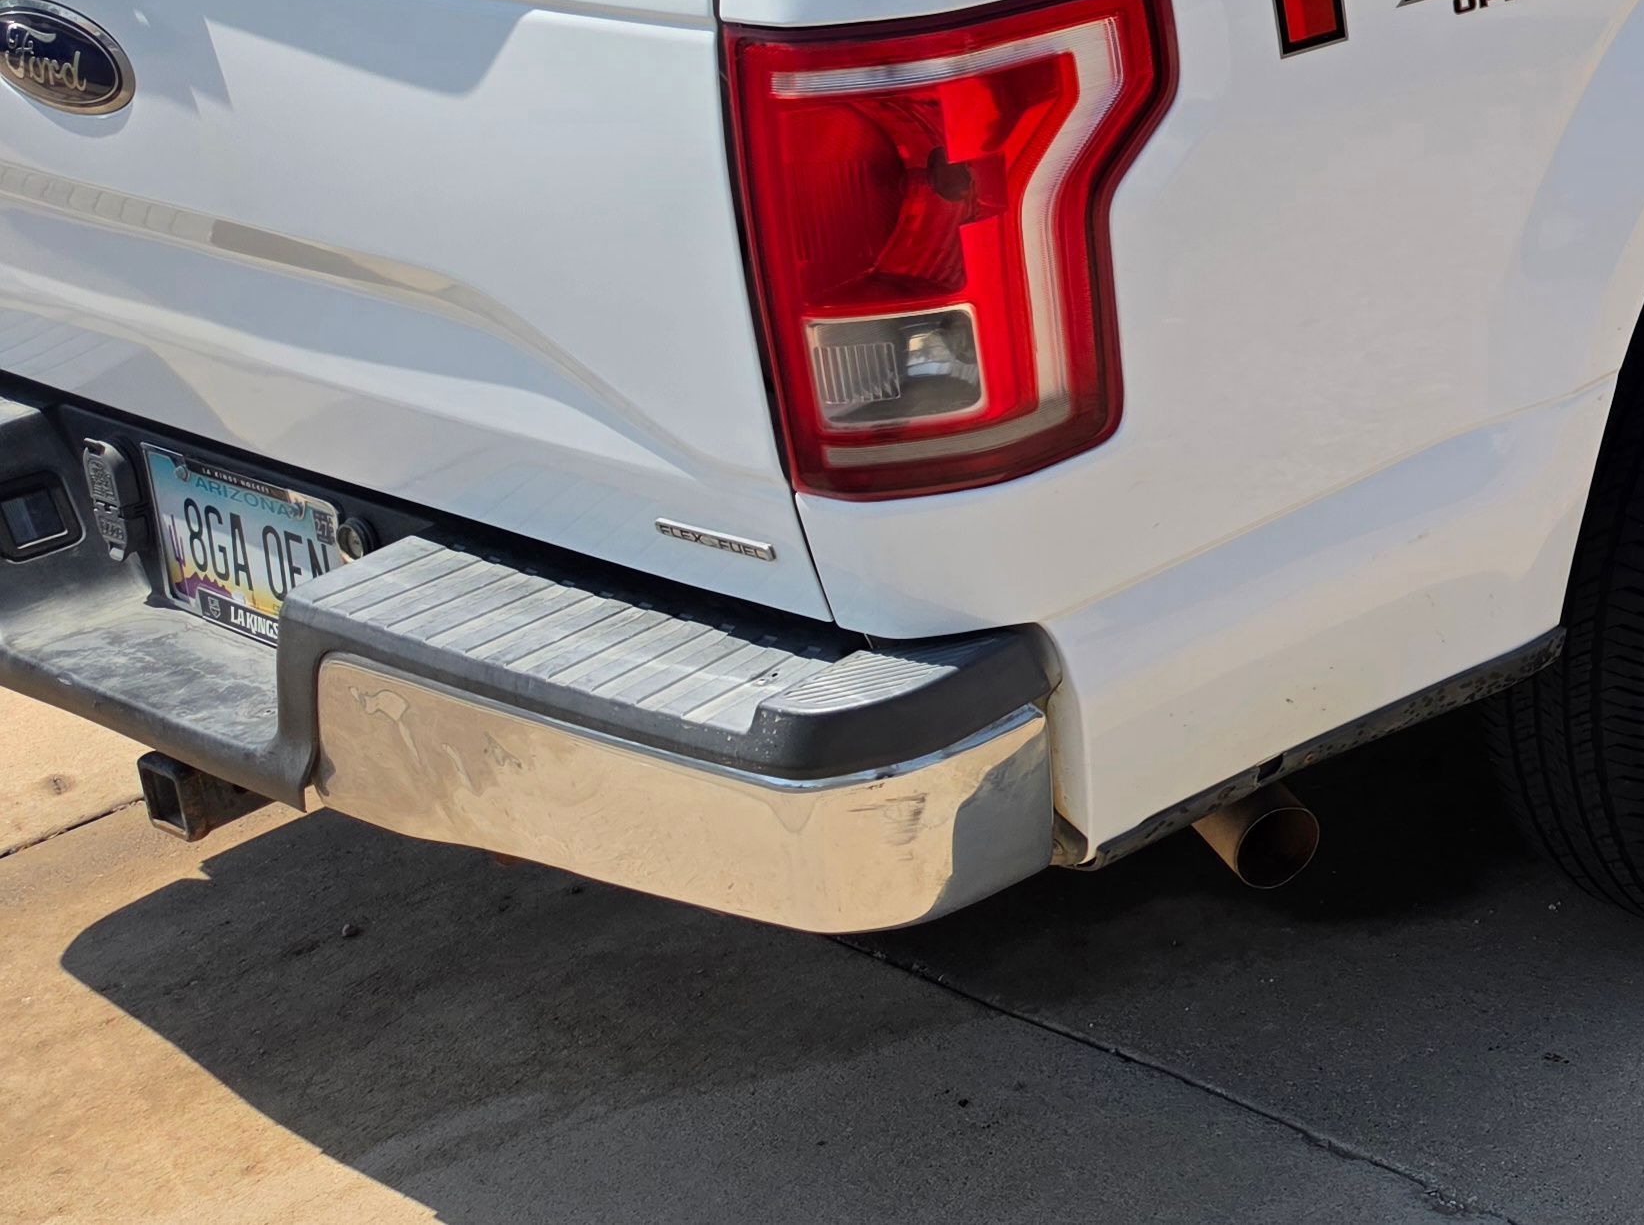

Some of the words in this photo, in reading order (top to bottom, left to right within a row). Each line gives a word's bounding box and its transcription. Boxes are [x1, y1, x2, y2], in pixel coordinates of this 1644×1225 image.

[4, 21, 88, 92] Ford
[195, 476, 293, 517] ARIZONA
[183, 498, 254, 591] 8GA
[659, 524, 703, 543] FLEX
[717, 538, 768, 561] FUEL
[230, 605, 246, 627] LA
[245, 611, 279, 640] KINGS
